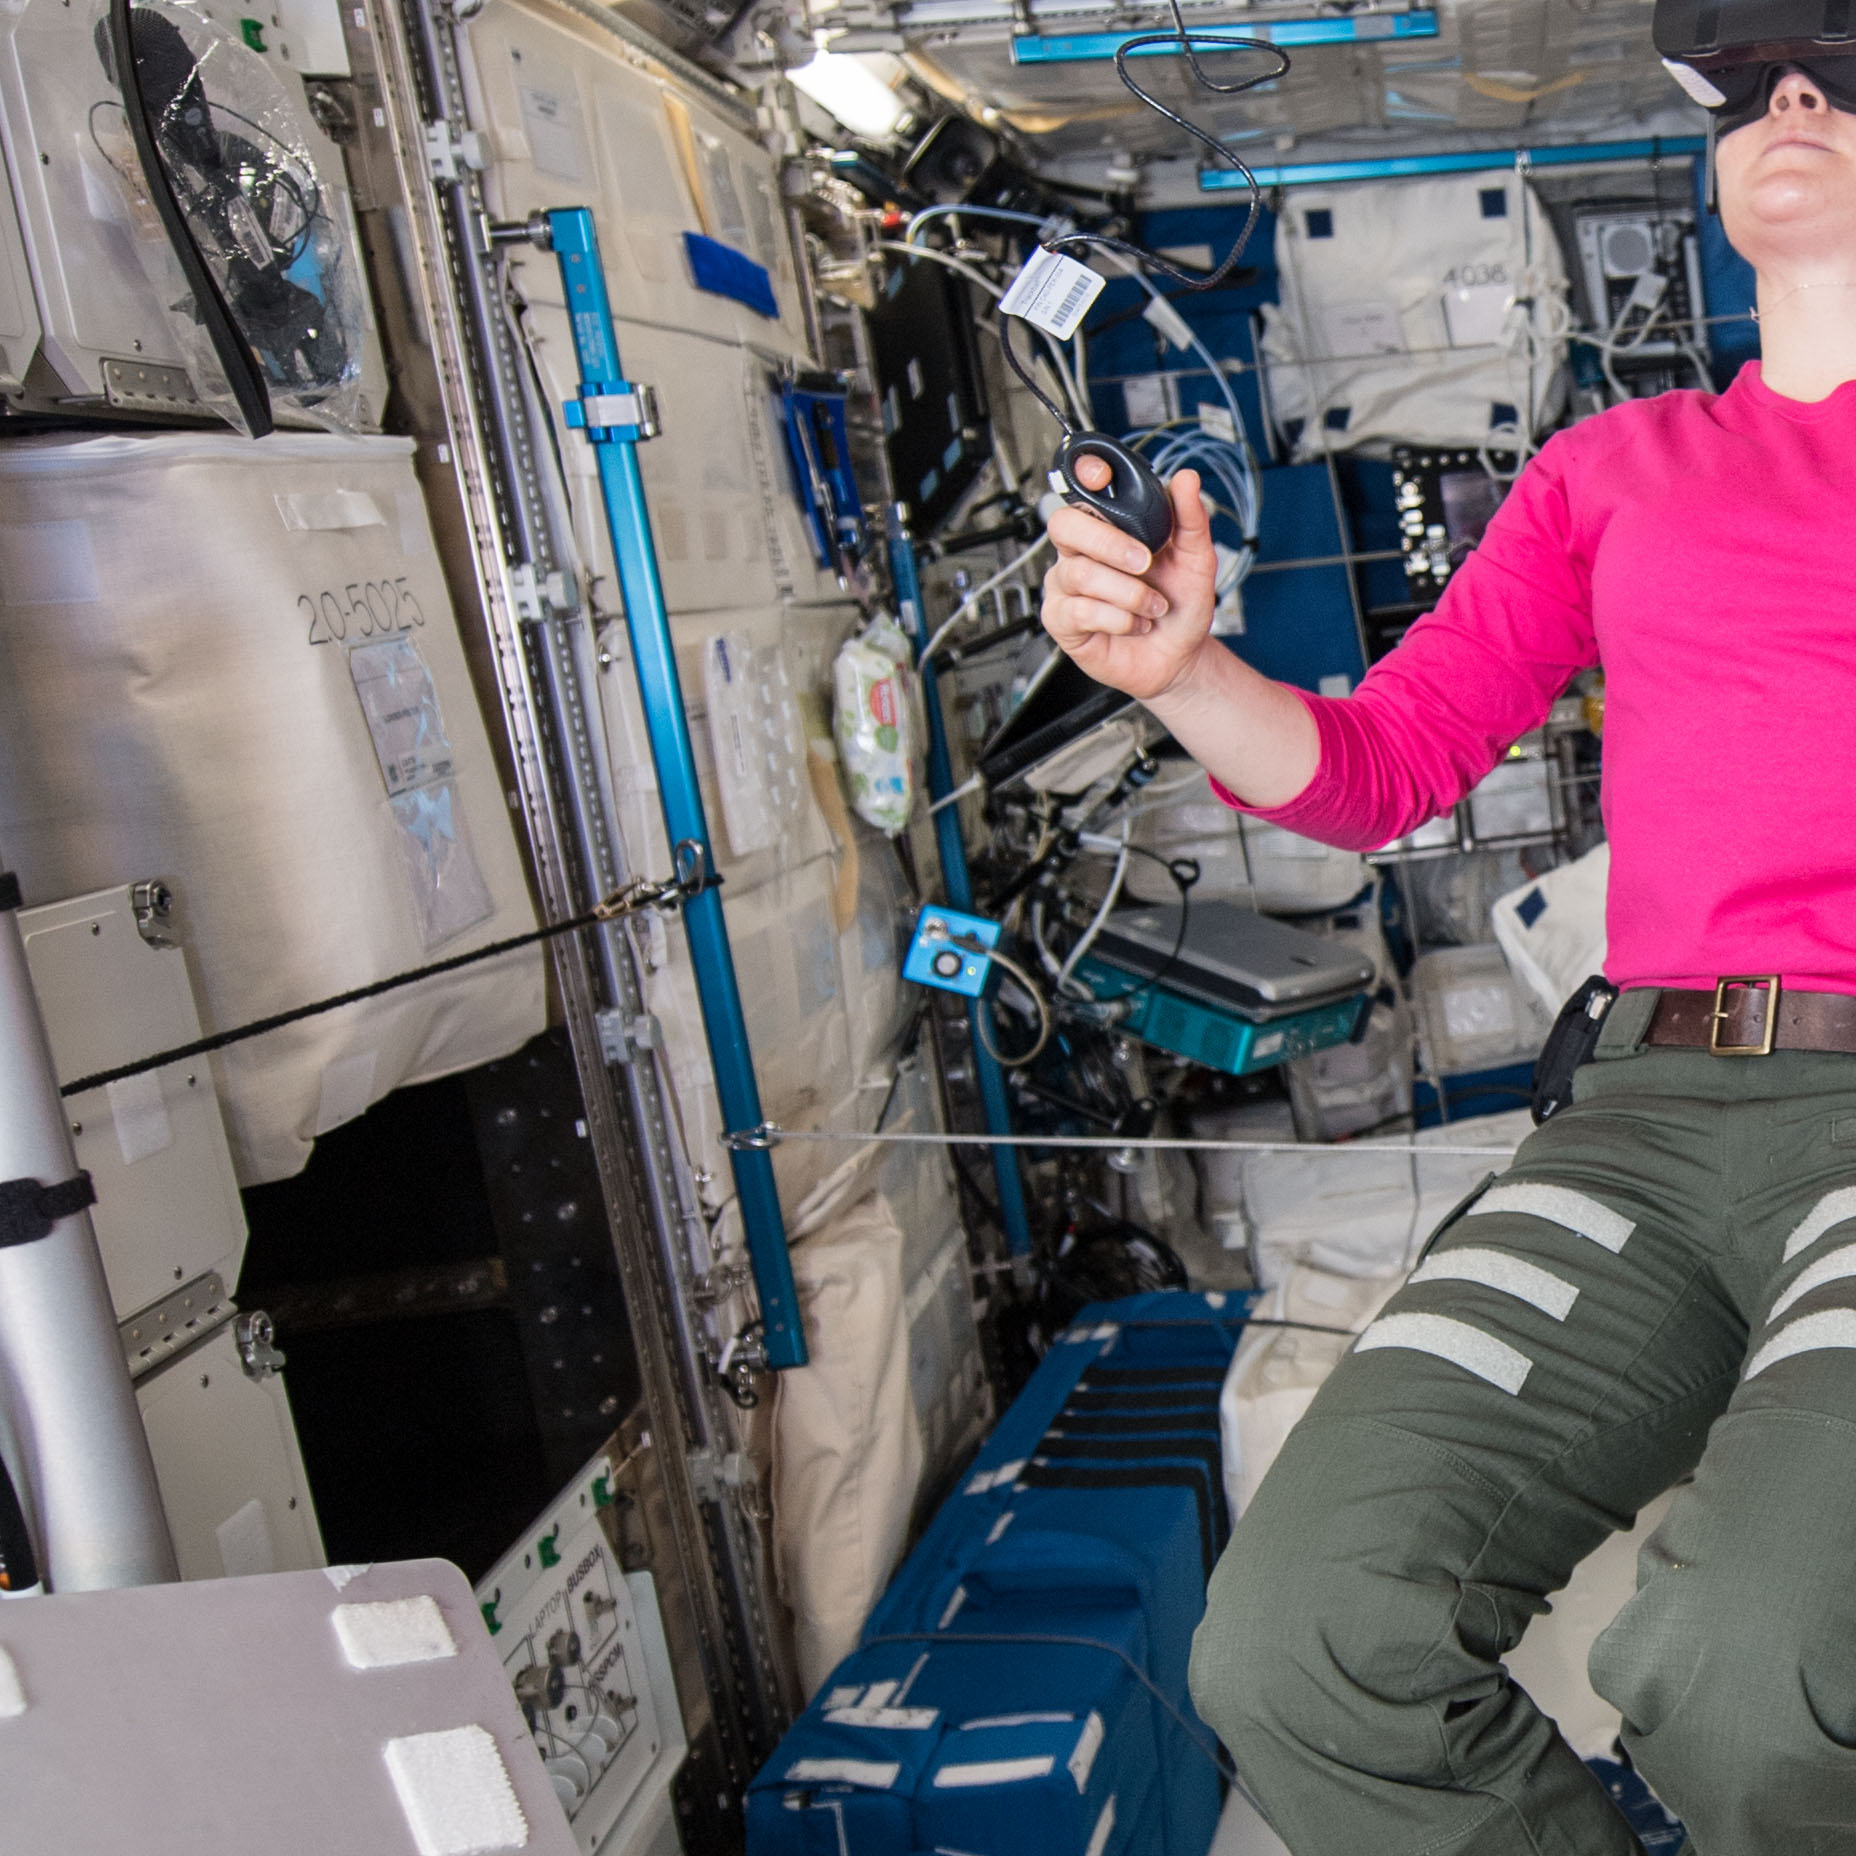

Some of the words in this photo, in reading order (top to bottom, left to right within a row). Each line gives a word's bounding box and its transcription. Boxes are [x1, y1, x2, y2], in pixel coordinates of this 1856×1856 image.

[1443, 263, 1507, 287] 4038
[295, 570, 426, 651] 2.0-5025
[561, 1543, 606, 1594] BUSBOX
